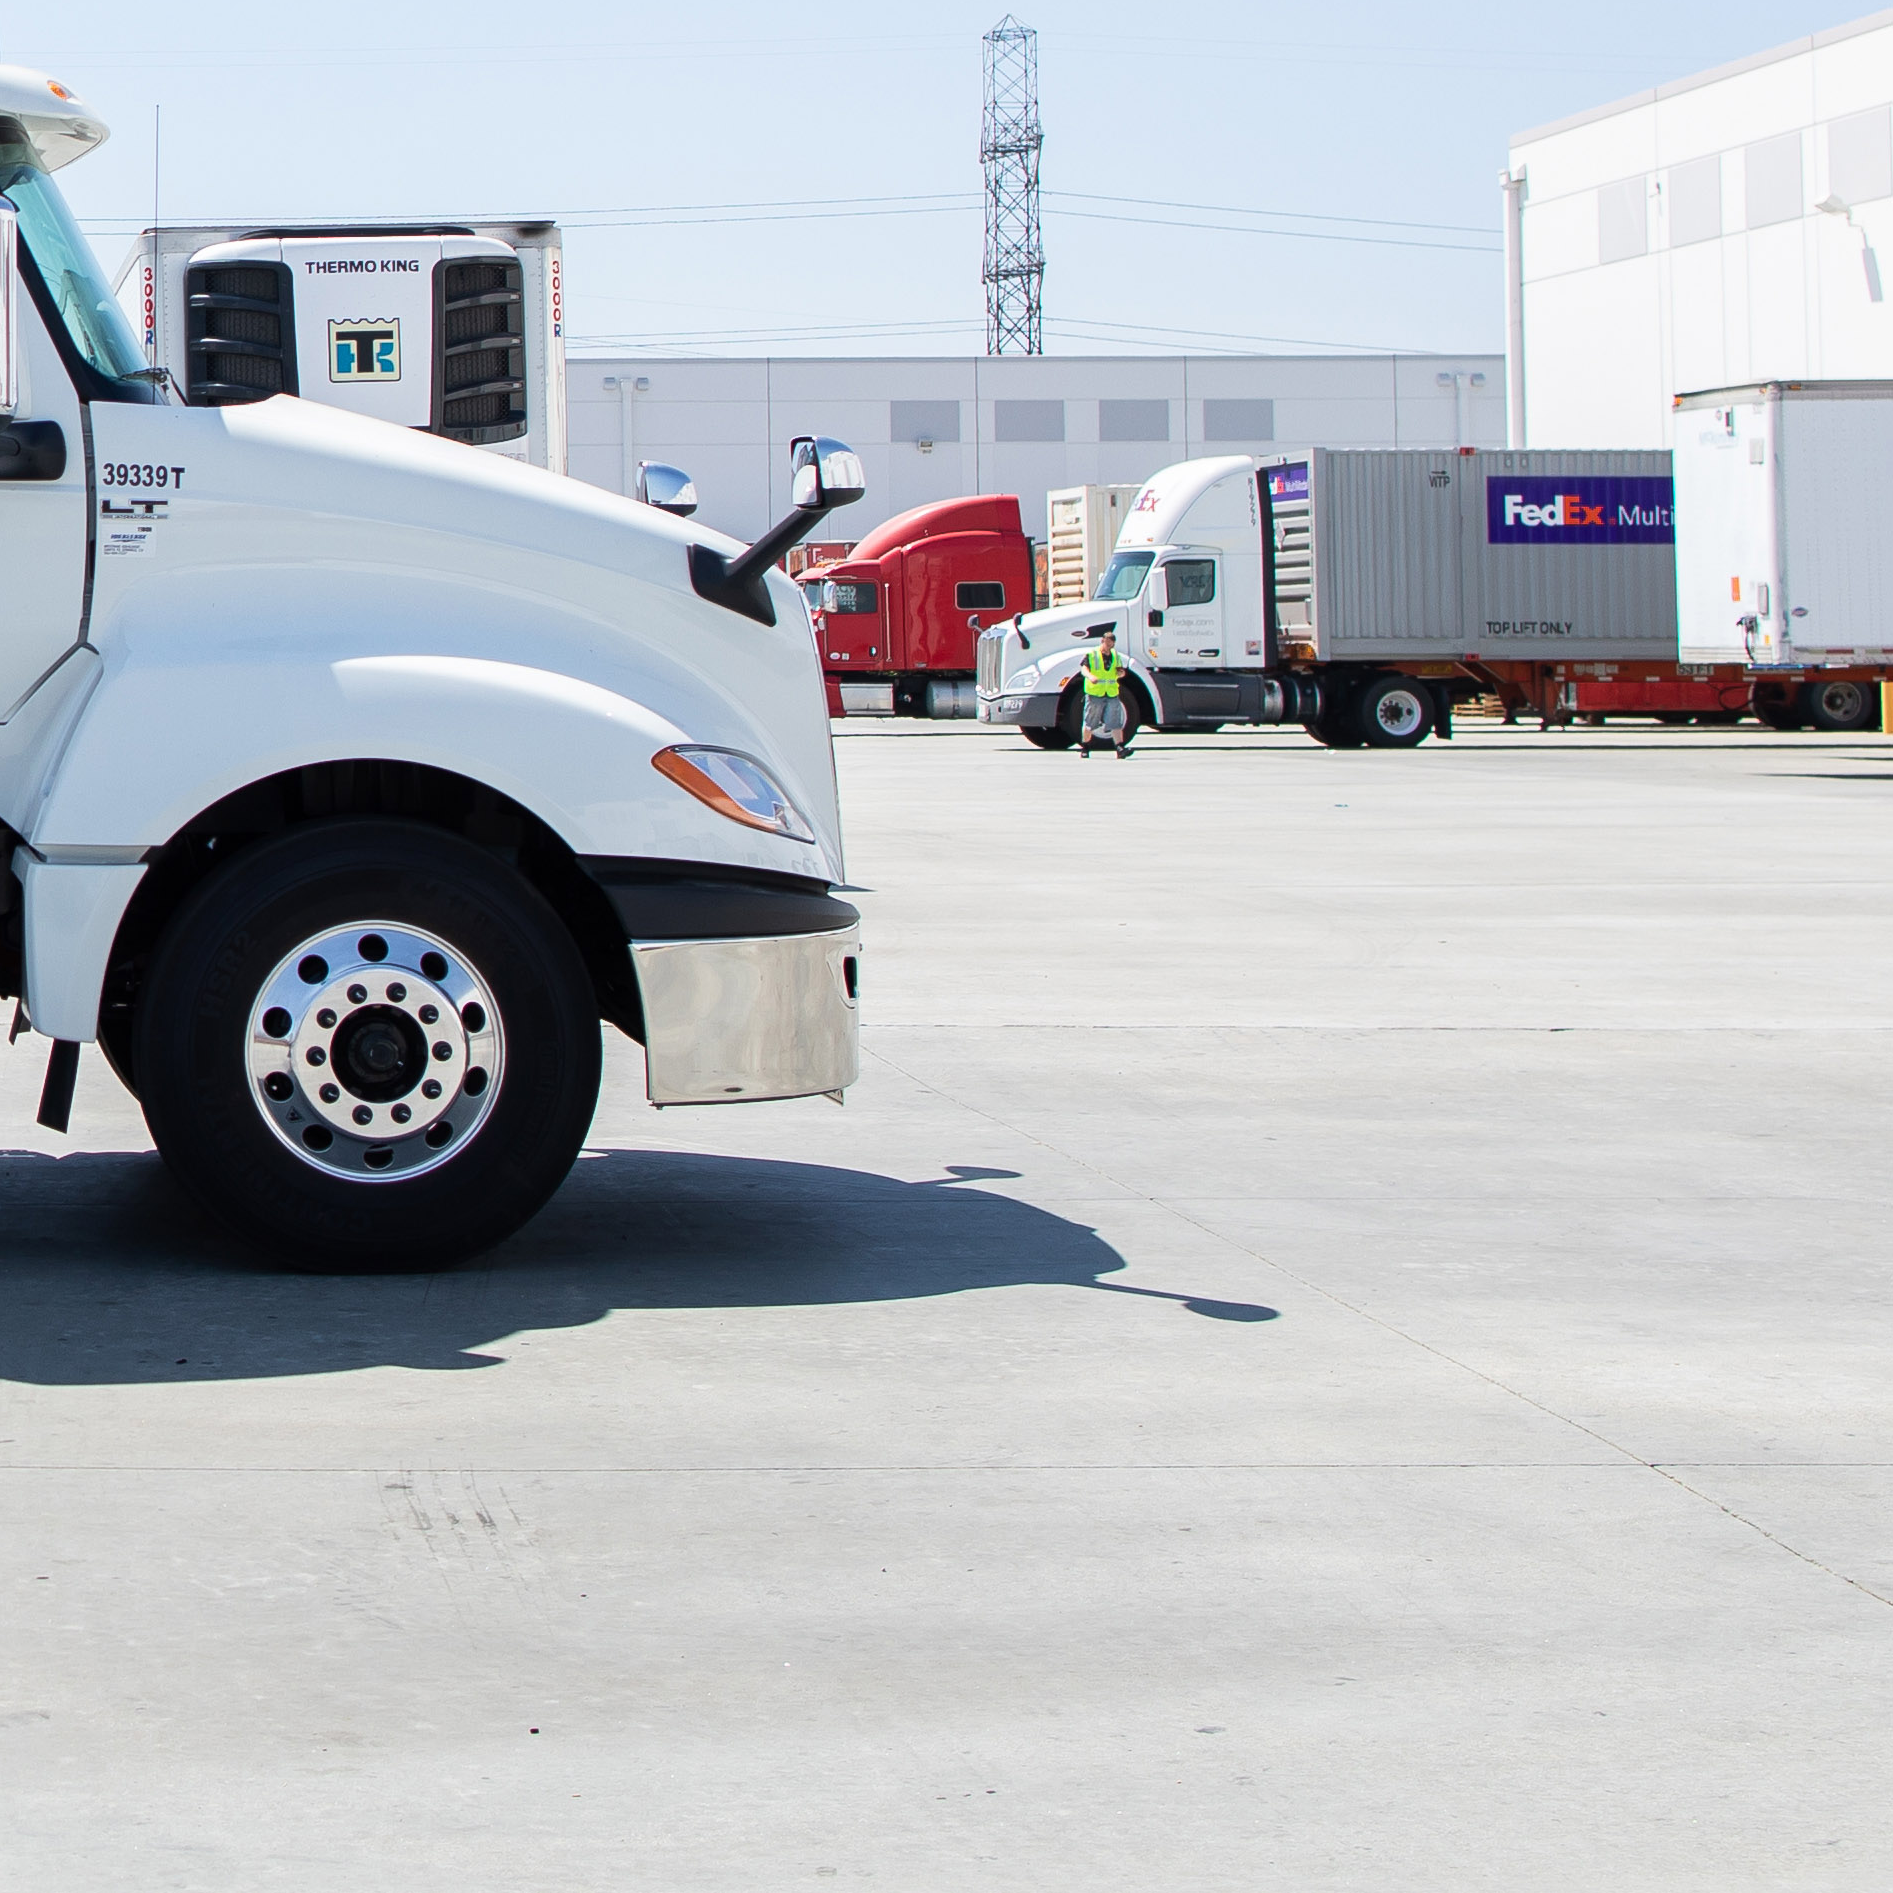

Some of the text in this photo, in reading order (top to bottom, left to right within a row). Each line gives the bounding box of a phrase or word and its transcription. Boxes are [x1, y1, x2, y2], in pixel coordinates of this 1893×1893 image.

[305, 259, 420, 274] THERMO KING
[144, 267, 155, 345] 3000R
[552, 260, 562, 338] 3000R
[101, 499, 168, 514] LT
[1504, 495, 1605, 527] FedEx
[1485, 620, 1573, 635] TOP LIFT ONLY
